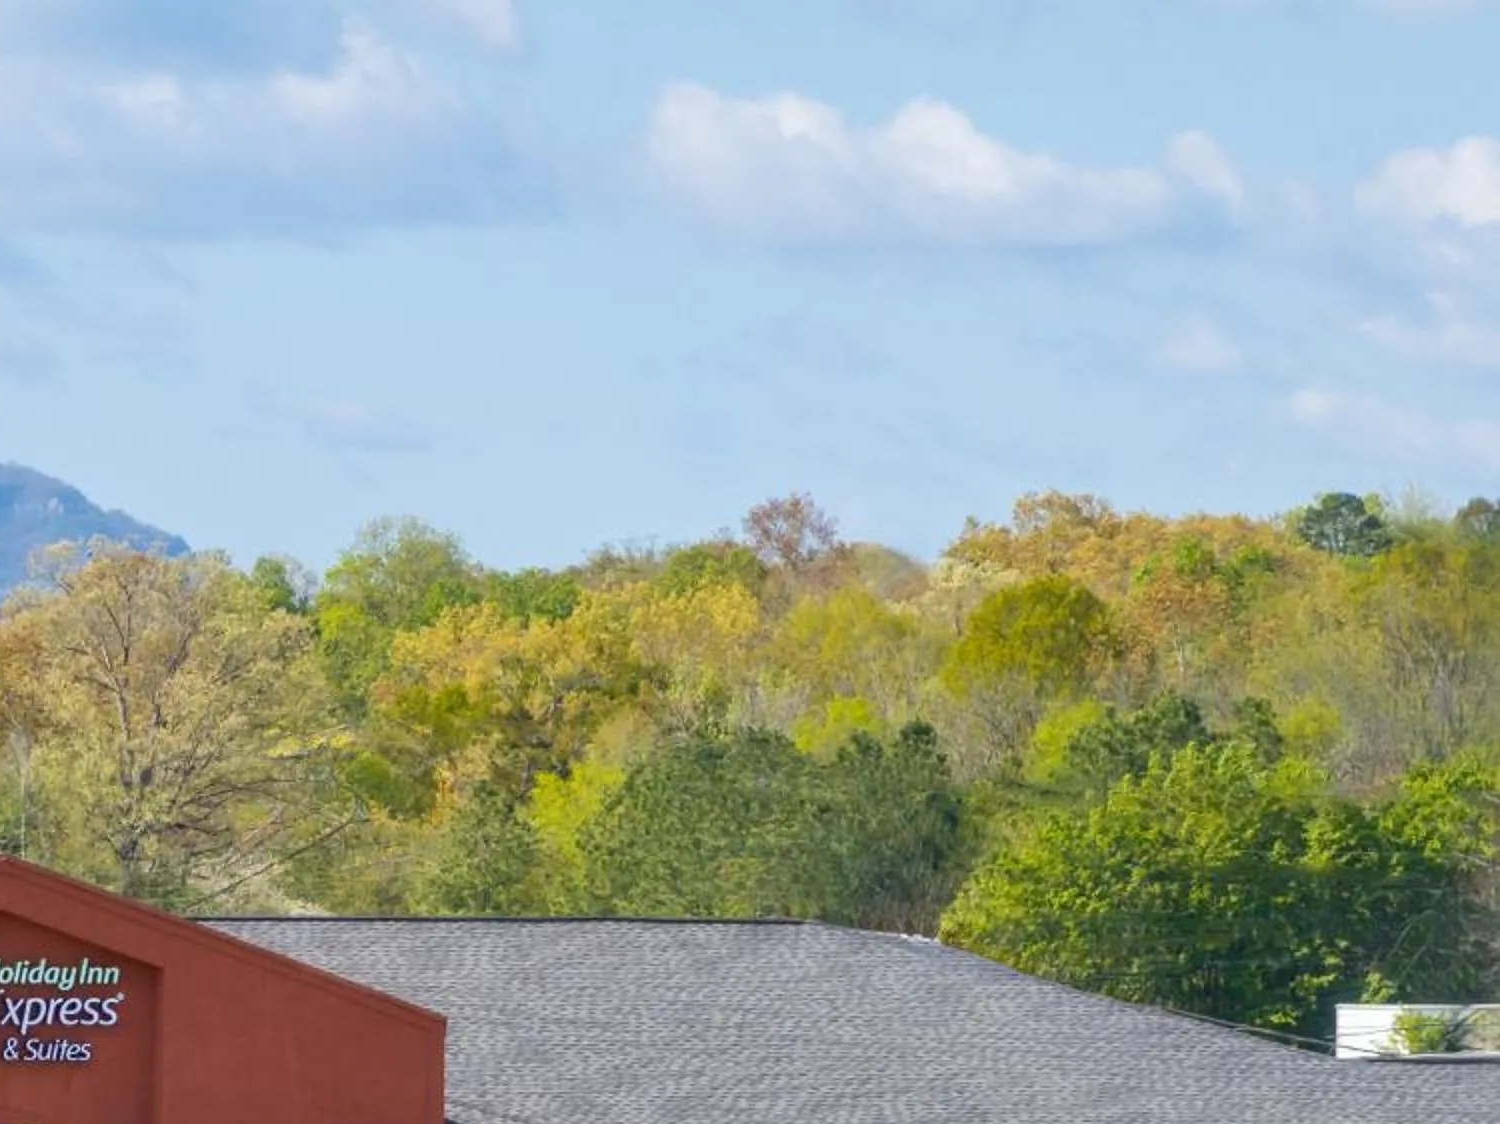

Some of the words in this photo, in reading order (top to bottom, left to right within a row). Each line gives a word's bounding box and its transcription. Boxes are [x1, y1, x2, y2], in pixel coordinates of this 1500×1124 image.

[79, 958, 120, 985] Inn
[3, 1037, 20, 1061] &
[23, 1037, 92, 1061] Suites
